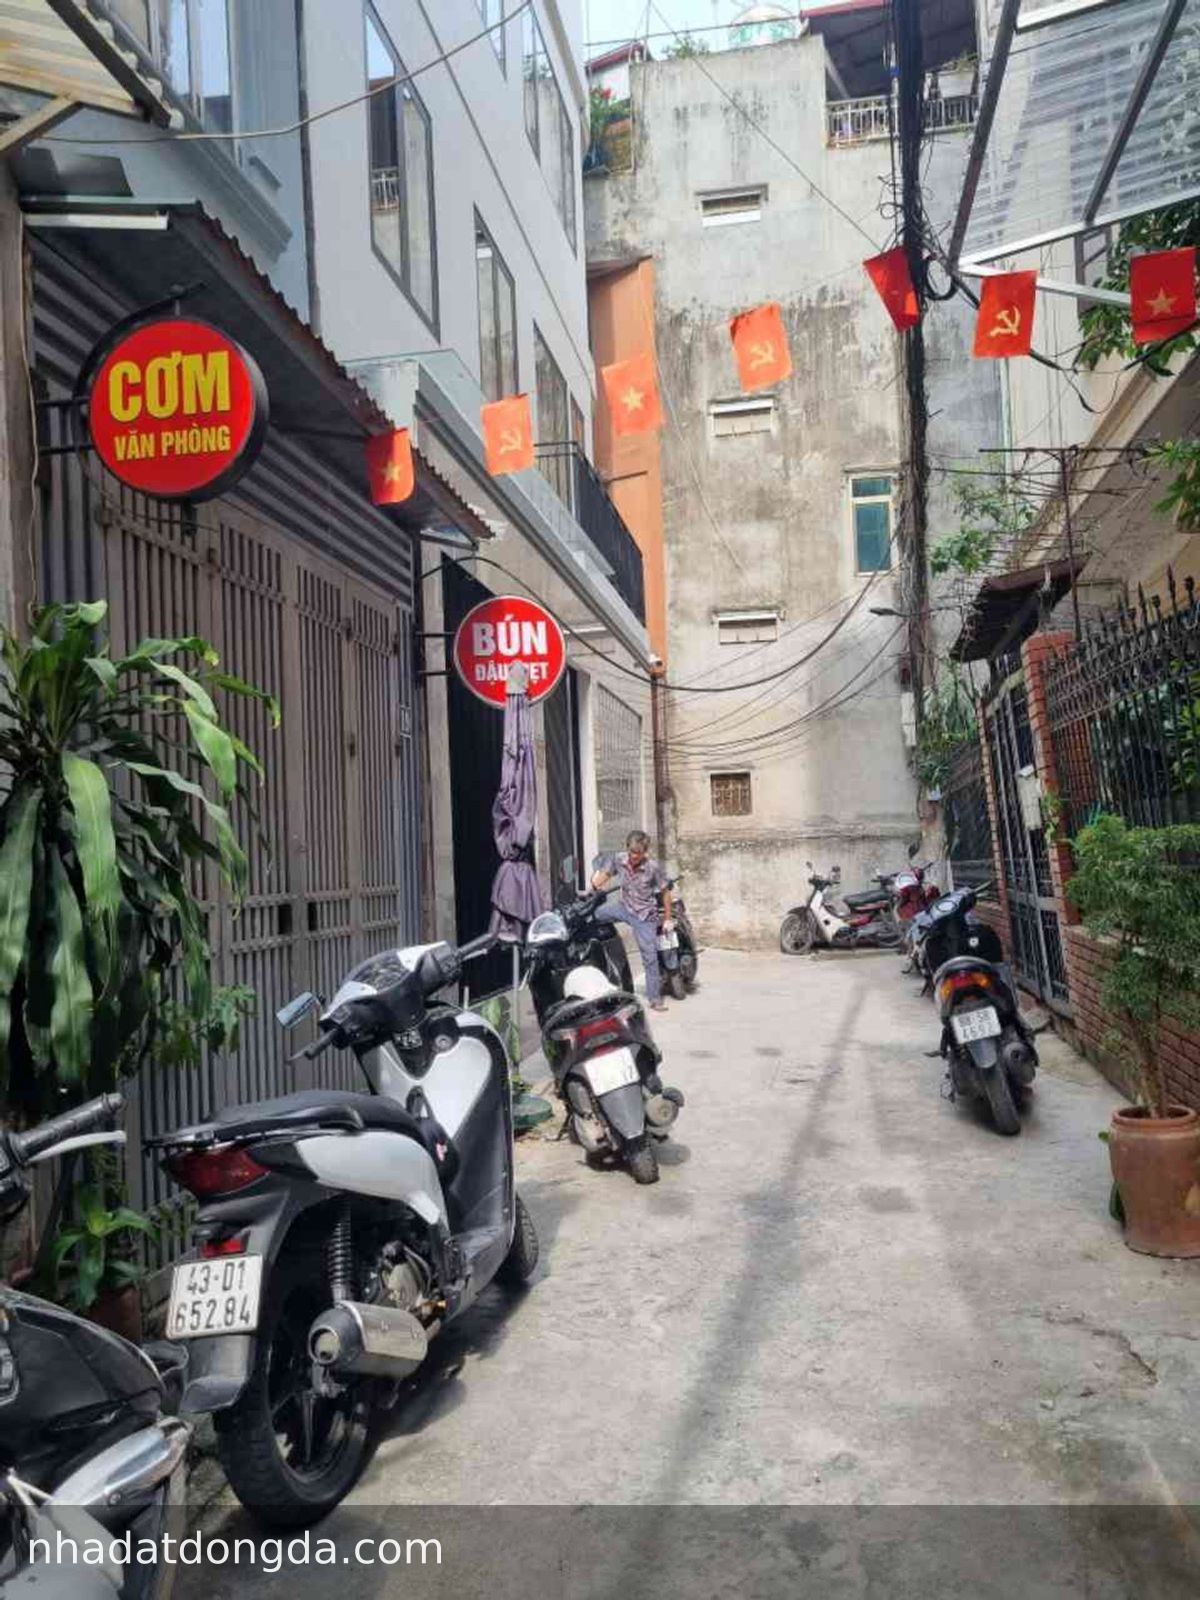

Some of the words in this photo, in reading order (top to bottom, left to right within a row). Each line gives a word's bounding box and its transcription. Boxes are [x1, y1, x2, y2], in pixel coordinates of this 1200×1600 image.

[108, 350, 231, 422] CƠM
[114, 430, 155, 461] VĂN
[161, 423, 231, 456] PHÒNG
[472, 613, 548, 656] BÚN
